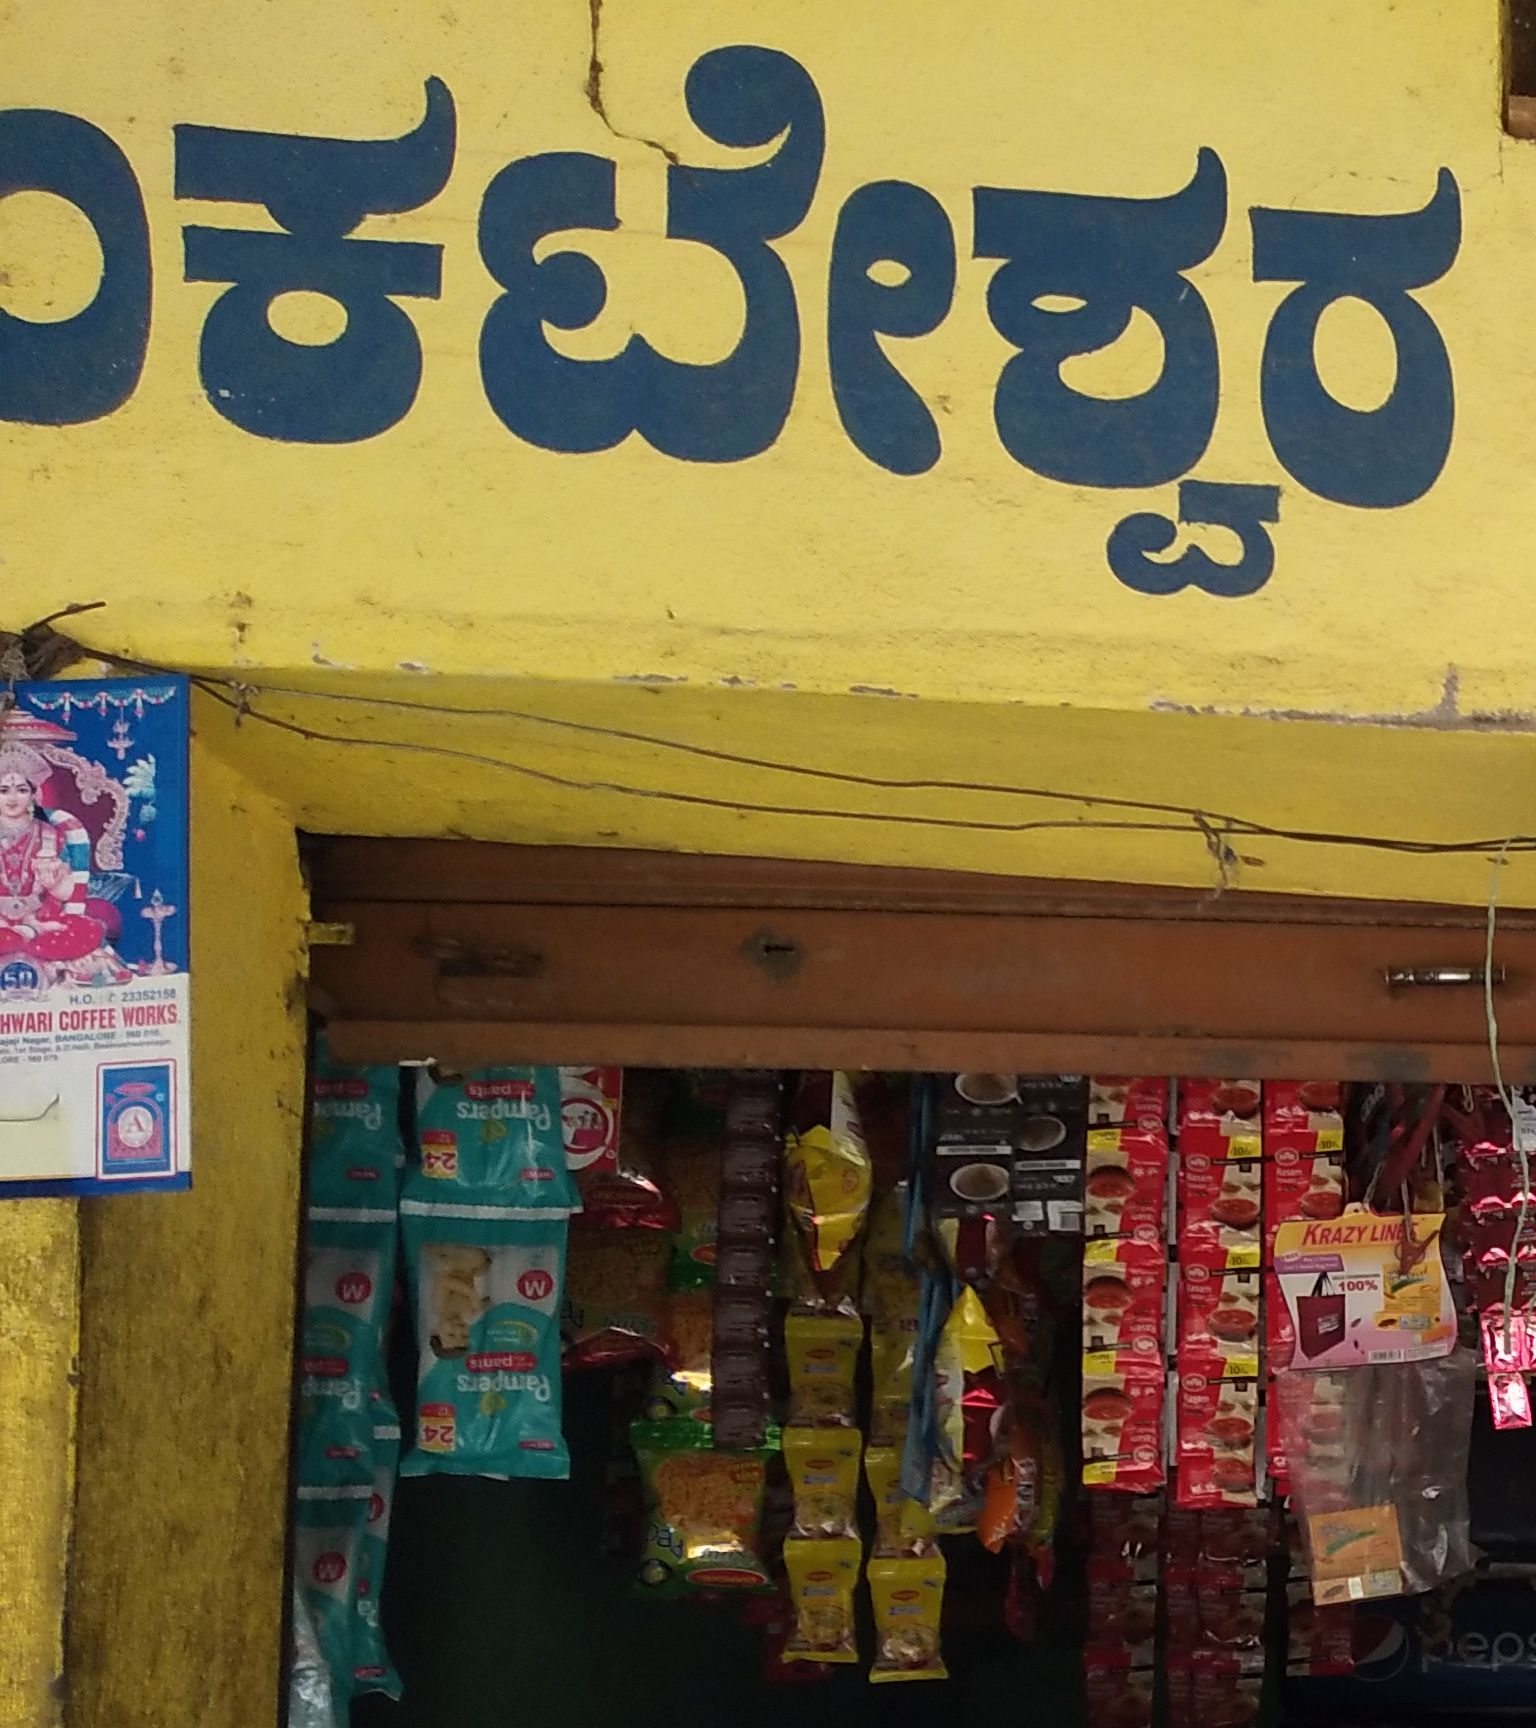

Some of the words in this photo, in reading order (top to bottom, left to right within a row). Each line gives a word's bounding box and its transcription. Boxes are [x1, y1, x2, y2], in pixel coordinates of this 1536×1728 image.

[58, 1007, 116, 1032] COFFEE
[55, 1031, 116, 1043] BANGALORE
[456, 1099, 552, 1131] Pampers
[424, 1152, 456, 1171] 24
[1303, 1223, 1367, 1246] KRAZY
[1338, 1280, 1378, 1292] 100%
[456, 1370, 552, 1401] Pampers
[424, 1425, 454, 1444] 24
